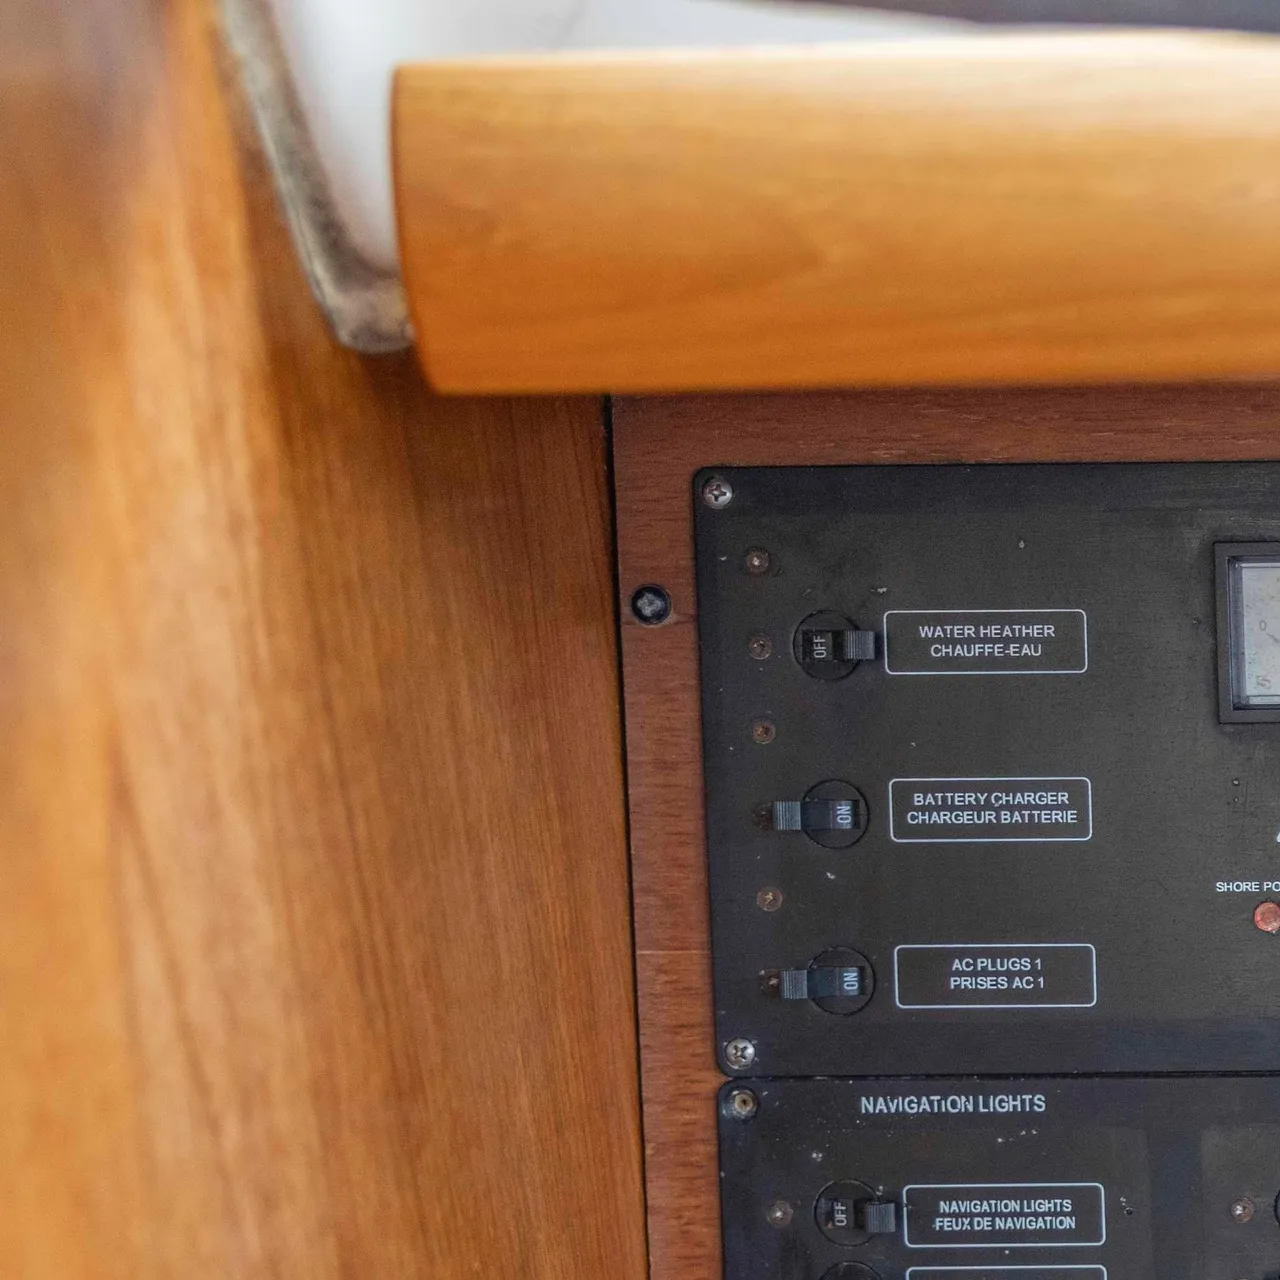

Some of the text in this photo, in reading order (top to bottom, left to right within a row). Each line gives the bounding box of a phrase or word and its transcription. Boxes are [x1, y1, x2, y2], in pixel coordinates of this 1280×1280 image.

[919, 625, 1055, 637] WATER HEATHER
[813, 634, 826, 659] OFF
[931, 644, 1041, 657] CHAUFFE-EAU
[914, 792, 1069, 807] BATTERY CHARGER
[837, 805, 852, 823] ON
[908, 811, 1077, 824] CHARGEUR BATTERIE
[1216, 882, 1259, 892] SHORE
[952, 958, 1040, 971] AC PLUGS 1
[951, 977, 1043, 989] PRISES AC 1
[940, 1199, 1071, 1213] NAVIGATION LIGHTS
[936, 1216, 1075, 1230] FEUX DE NAVIGATION
